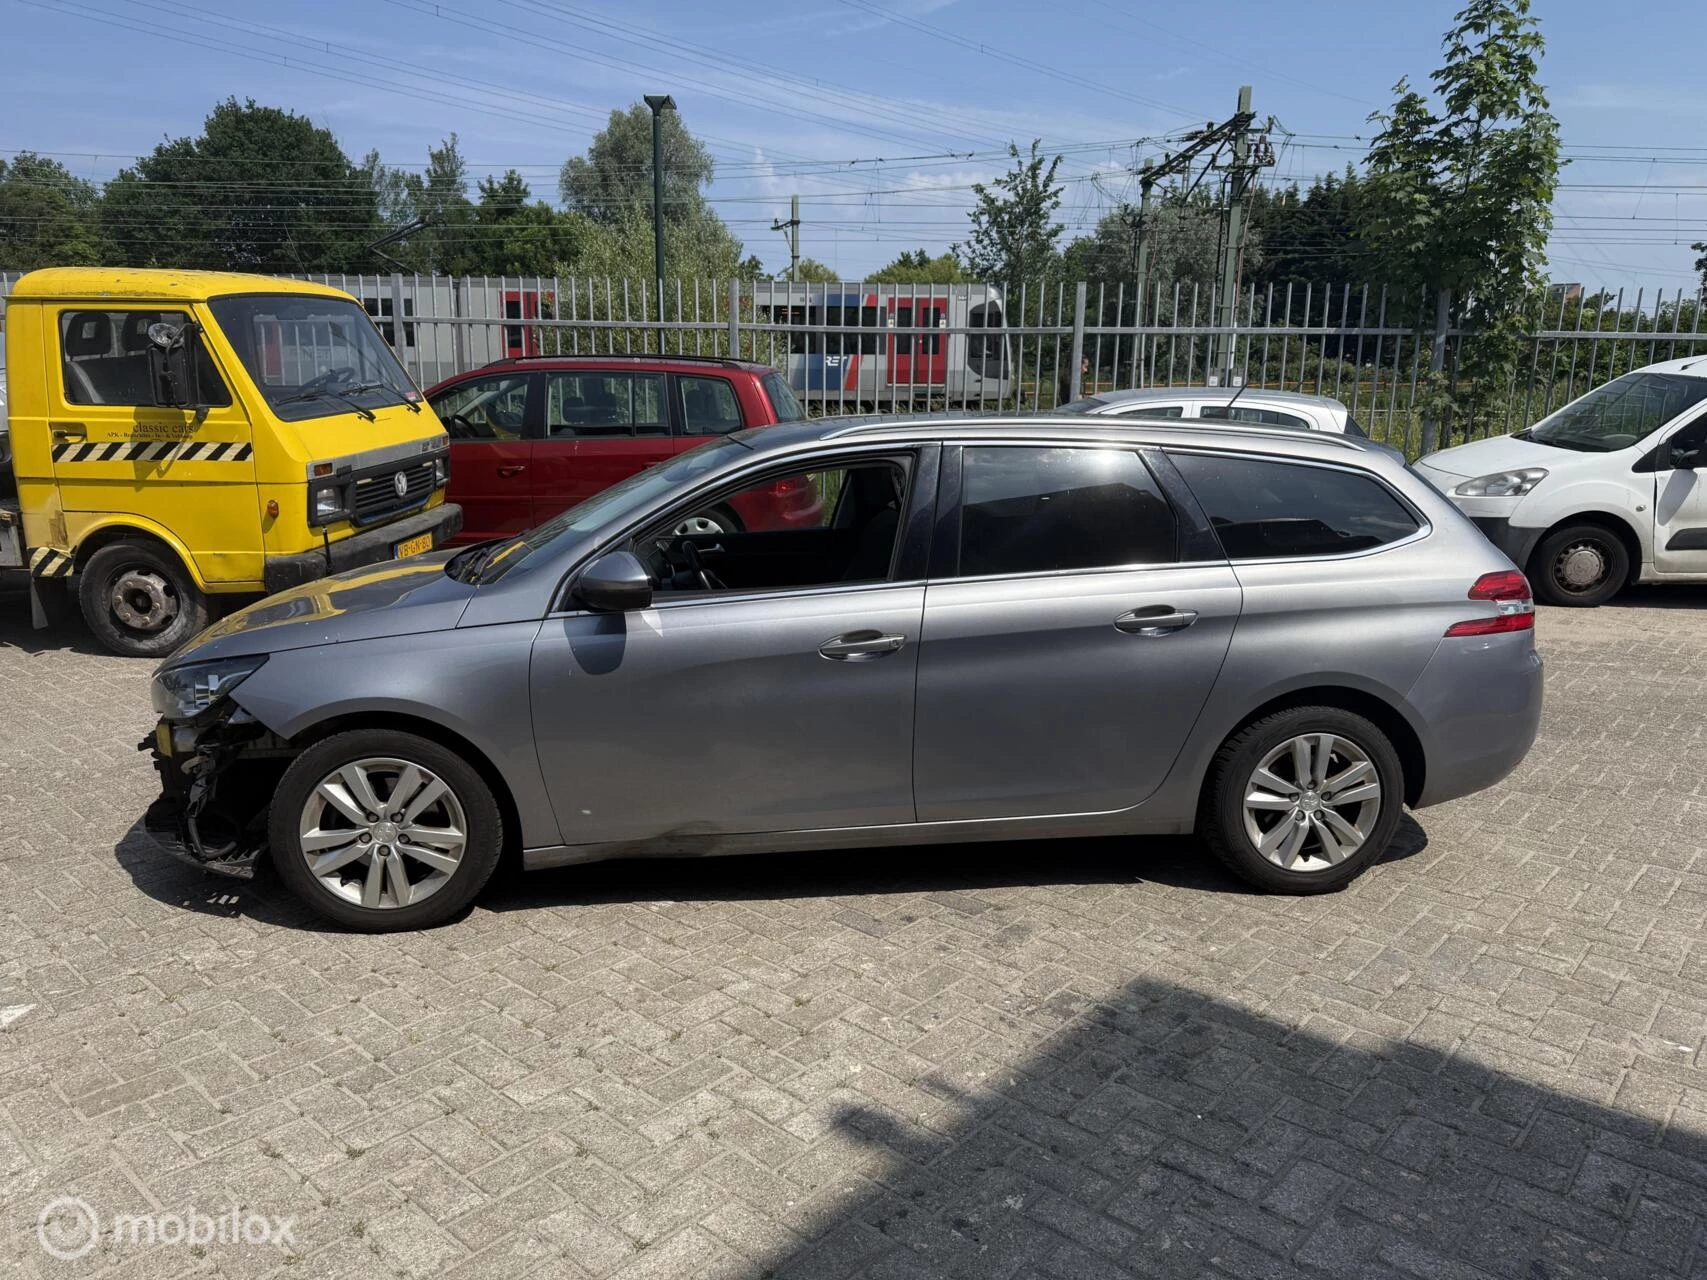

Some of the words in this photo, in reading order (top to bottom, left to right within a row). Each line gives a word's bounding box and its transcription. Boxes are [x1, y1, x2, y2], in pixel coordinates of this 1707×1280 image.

[825, 354, 848, 367] RET
[132, 422, 169, 433] classic
[171, 425, 194, 433] cars
